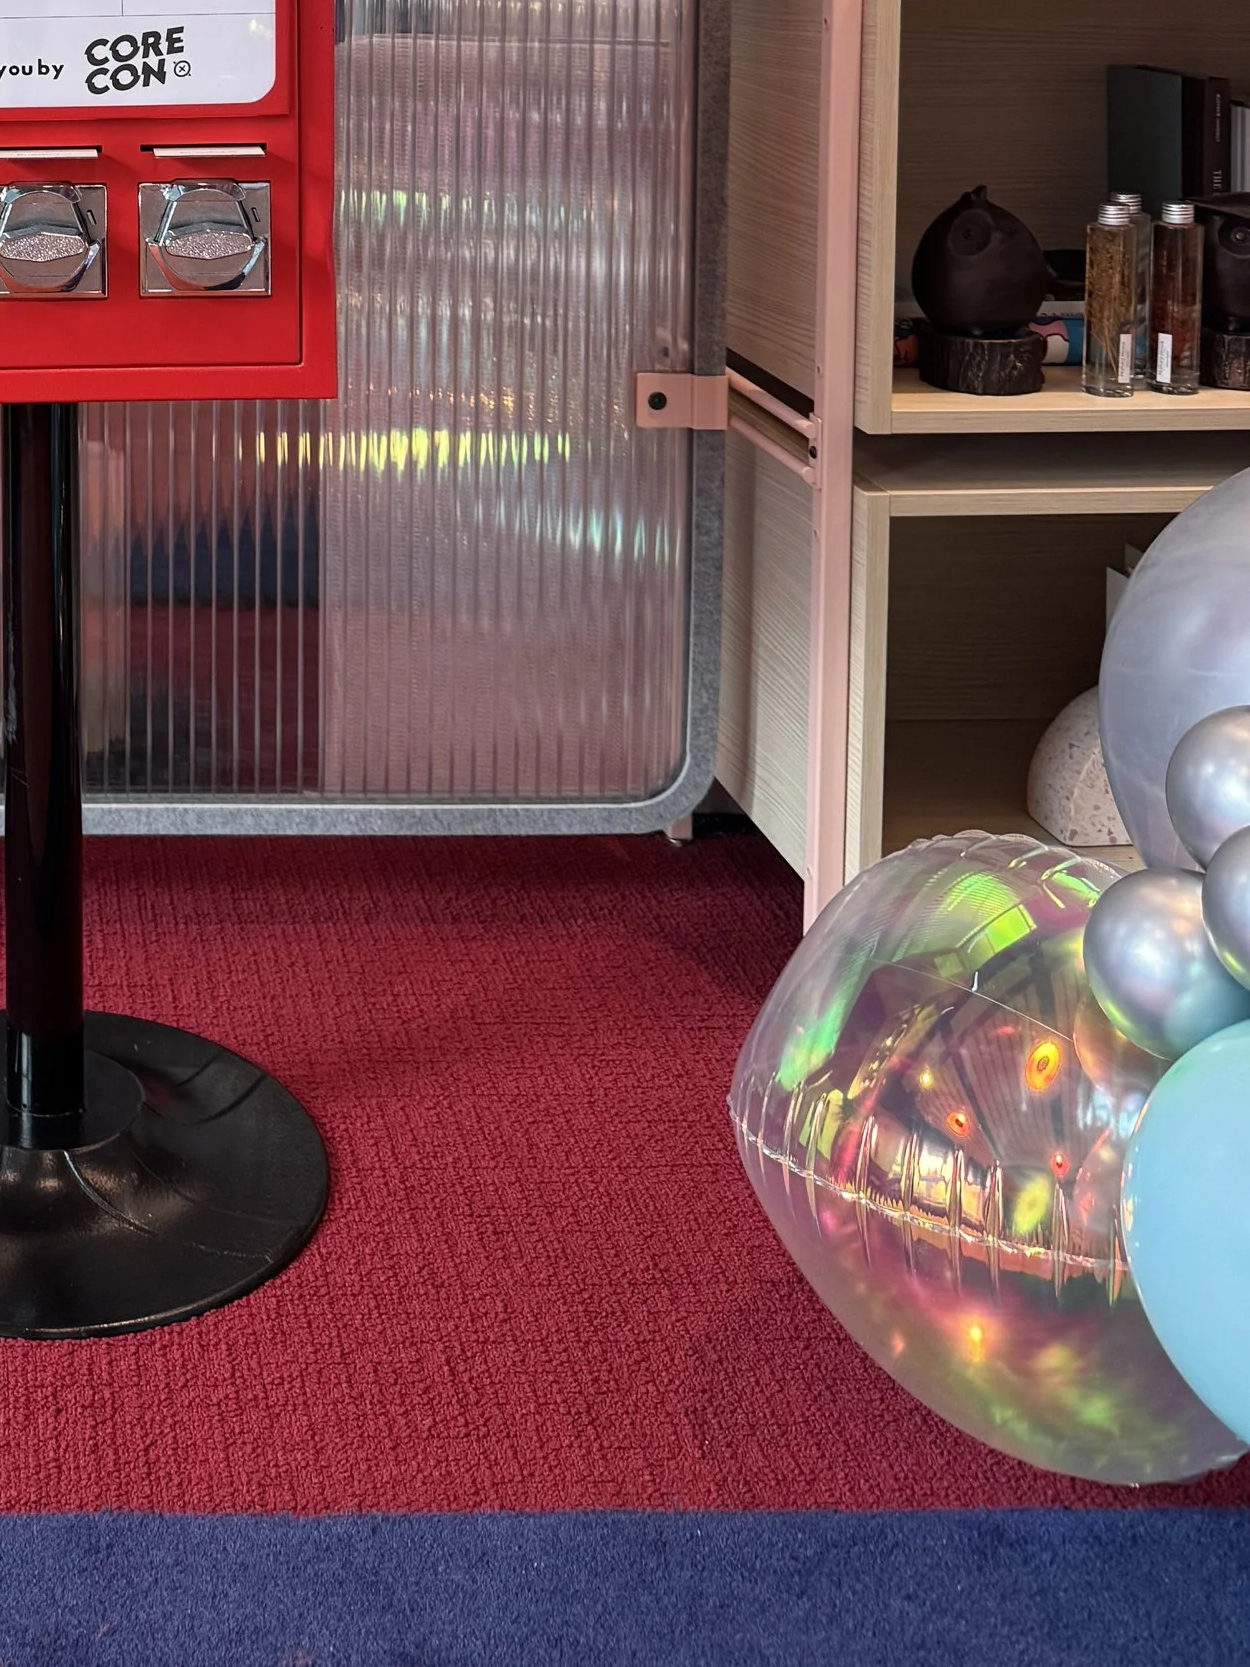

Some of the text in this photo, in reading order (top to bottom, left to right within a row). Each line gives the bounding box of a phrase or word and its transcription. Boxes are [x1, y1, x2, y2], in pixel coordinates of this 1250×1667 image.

[84, 26, 185, 66] CORE
[37, 58, 65, 80] by
[84, 58, 167, 95] CON
